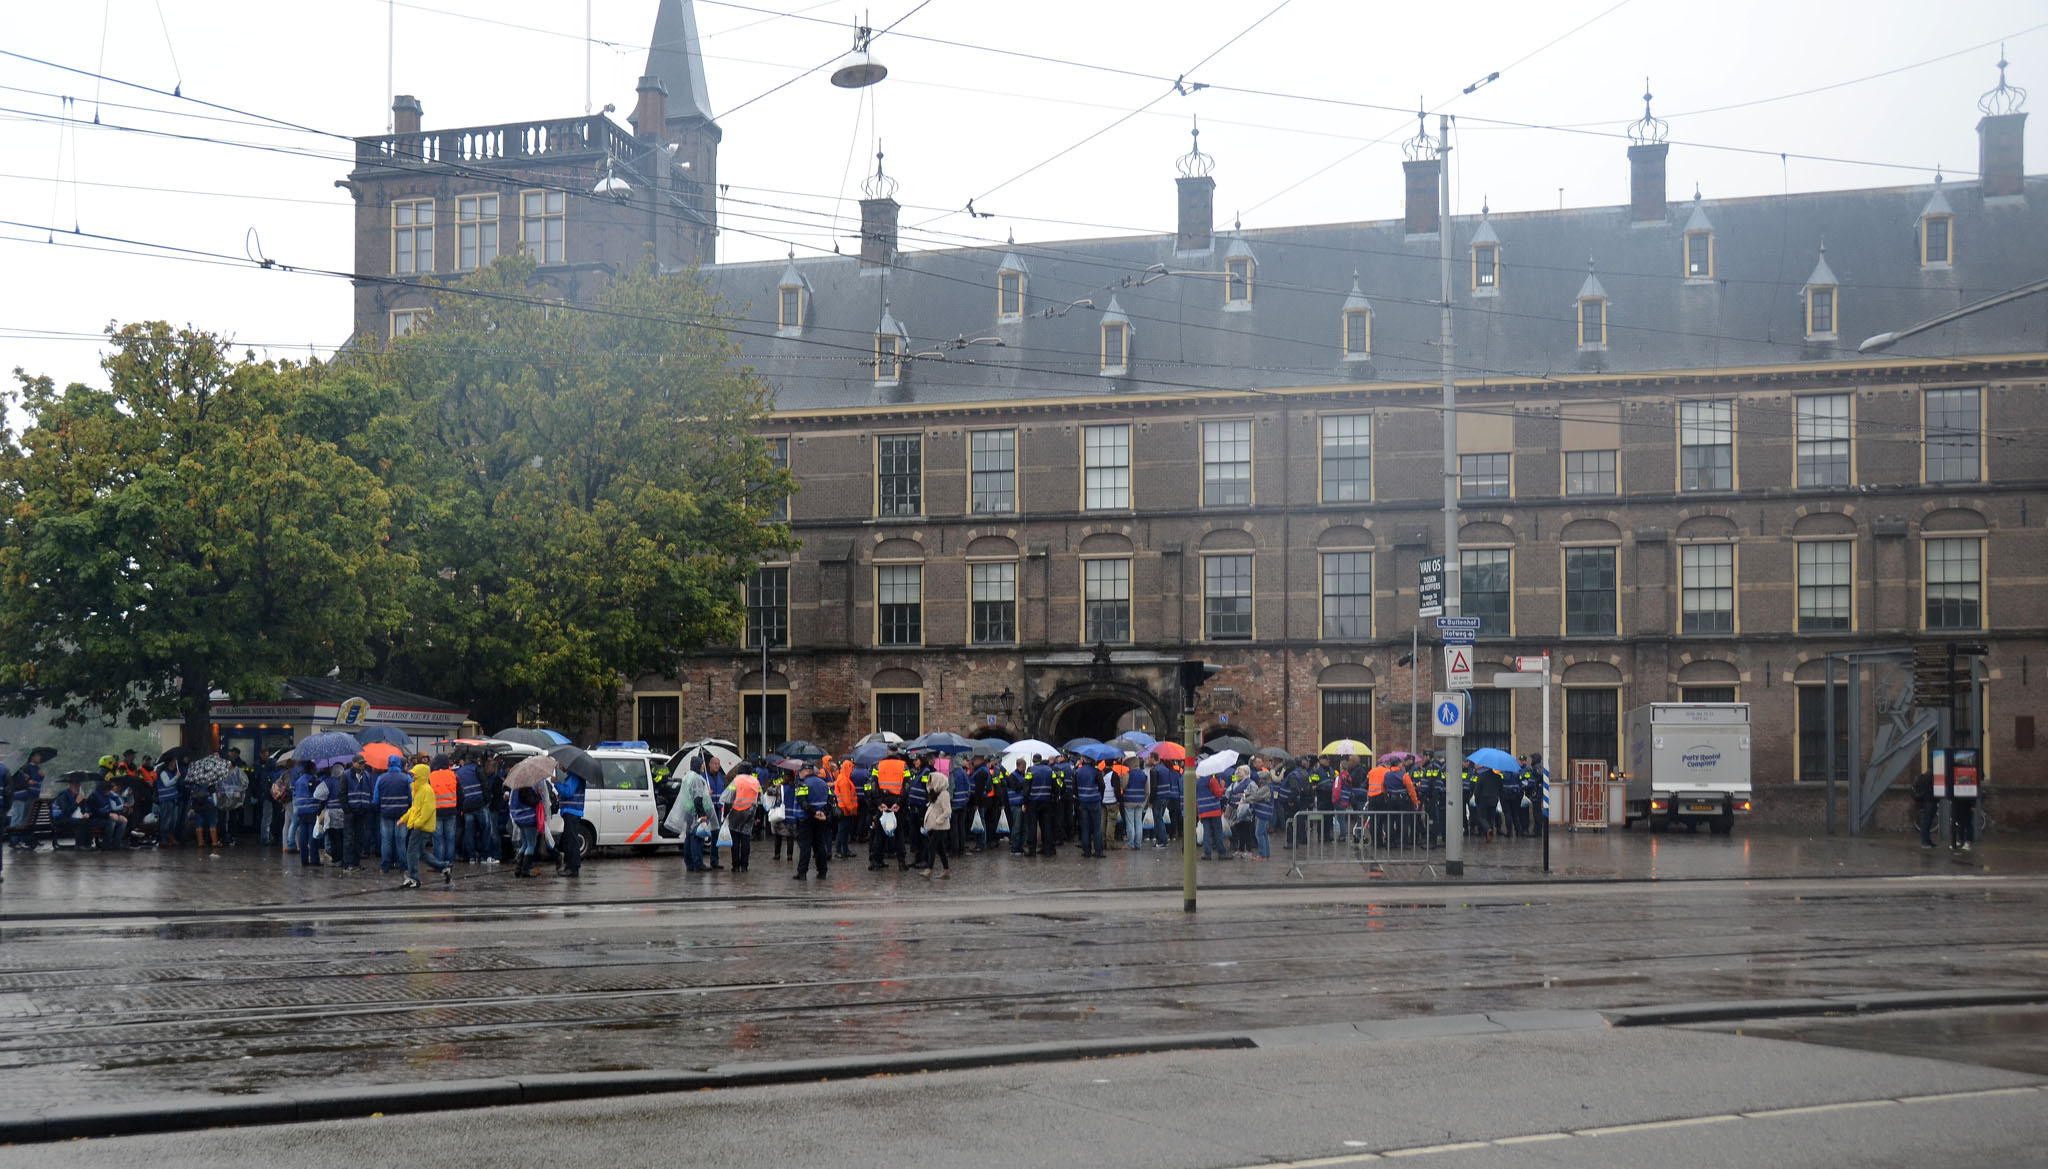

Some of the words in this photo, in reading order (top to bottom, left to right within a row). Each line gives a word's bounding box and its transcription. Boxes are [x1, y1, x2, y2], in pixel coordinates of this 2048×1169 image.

[1420, 560, 1431, 574] VAN
[1432, 559, 1441, 572] OS
[1444, 630, 1467, 638] Hofweg
[1700, 753, 1721, 761] Rental
[612, 804, 638, 813] POLITIE
